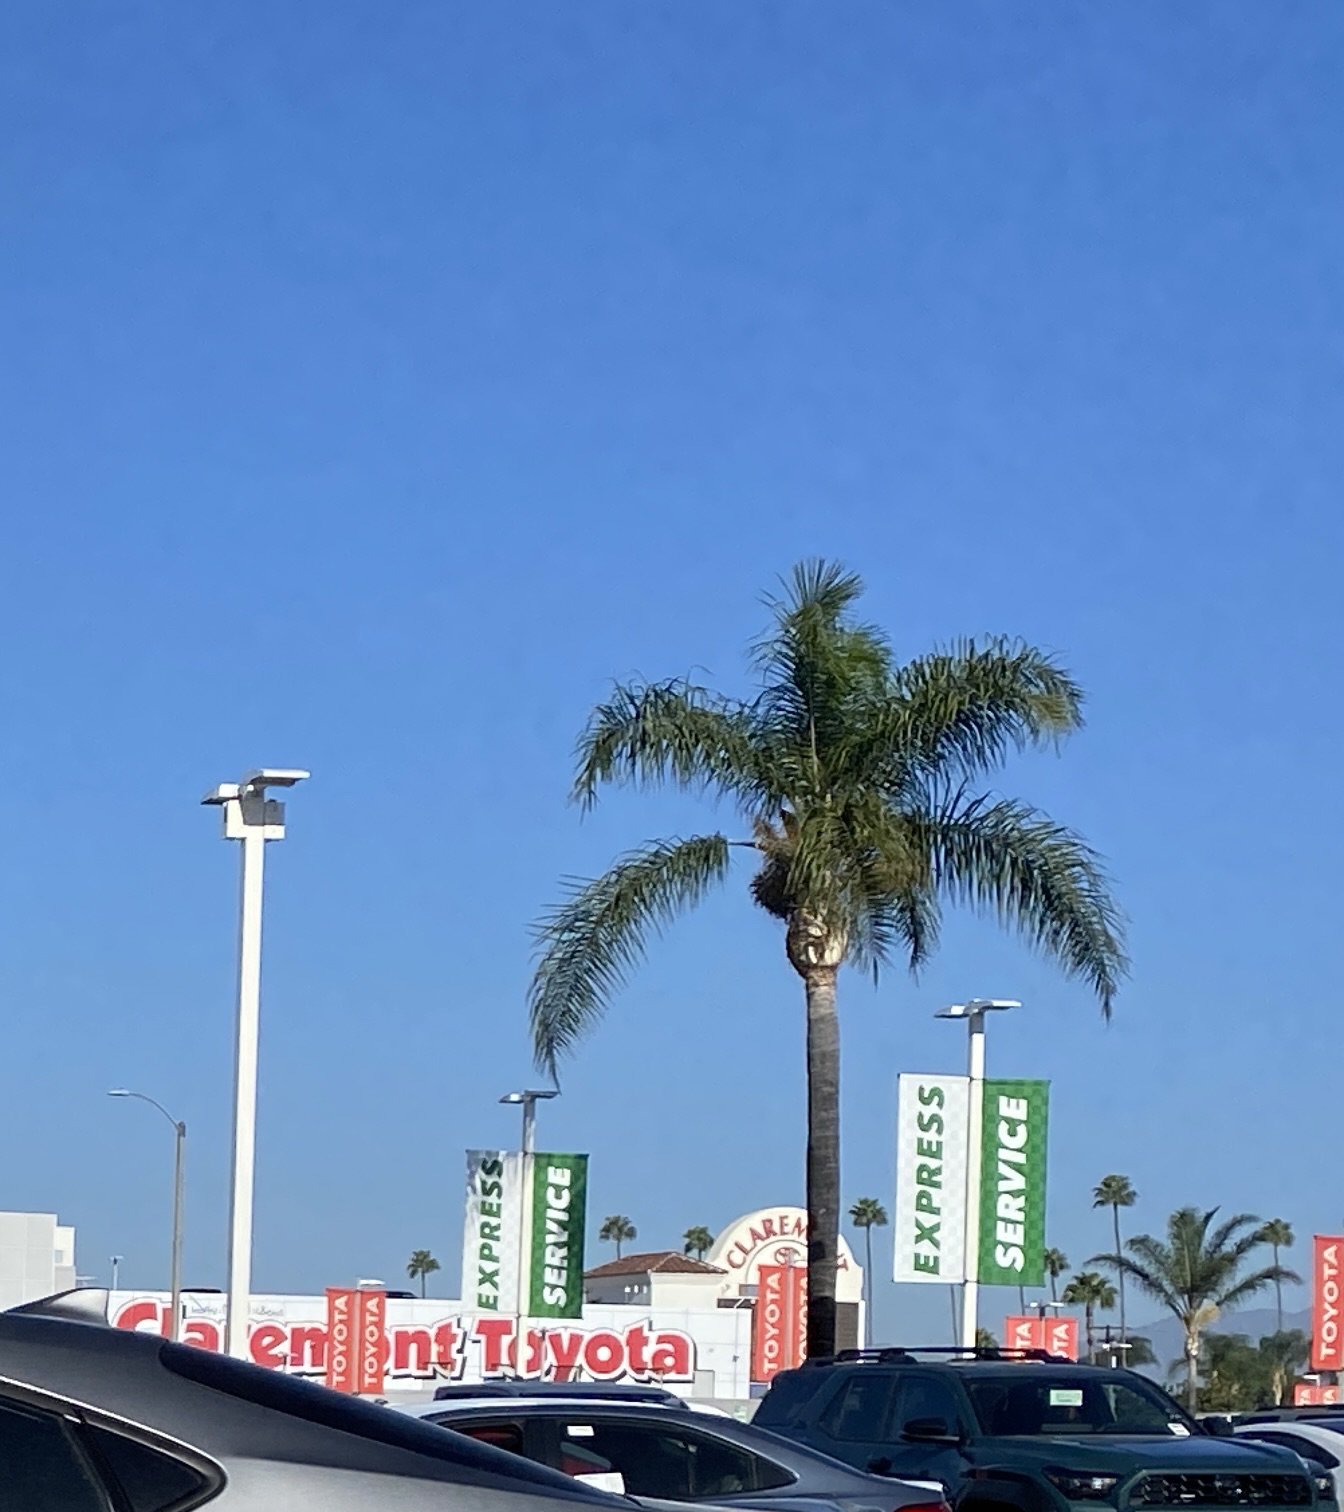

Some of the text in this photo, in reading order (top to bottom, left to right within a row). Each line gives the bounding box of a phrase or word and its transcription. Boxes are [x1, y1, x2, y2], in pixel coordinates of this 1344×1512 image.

[477, 1157, 504, 1311] EXPRESS
[543, 1165, 571, 1308] SERVICE
[914, 1084, 945, 1275] EXPRESS
[995, 1095, 1028, 1273] SERVICE
[332, 1295, 348, 1385] TOYOTA
[363, 1297, 379, 1386] TOYOTA
[475, 1319, 689, 1381] Toyota
[763, 1272, 781, 1374] TOYOTA
[1320, 1245, 1339, 1360] TOYOTA
